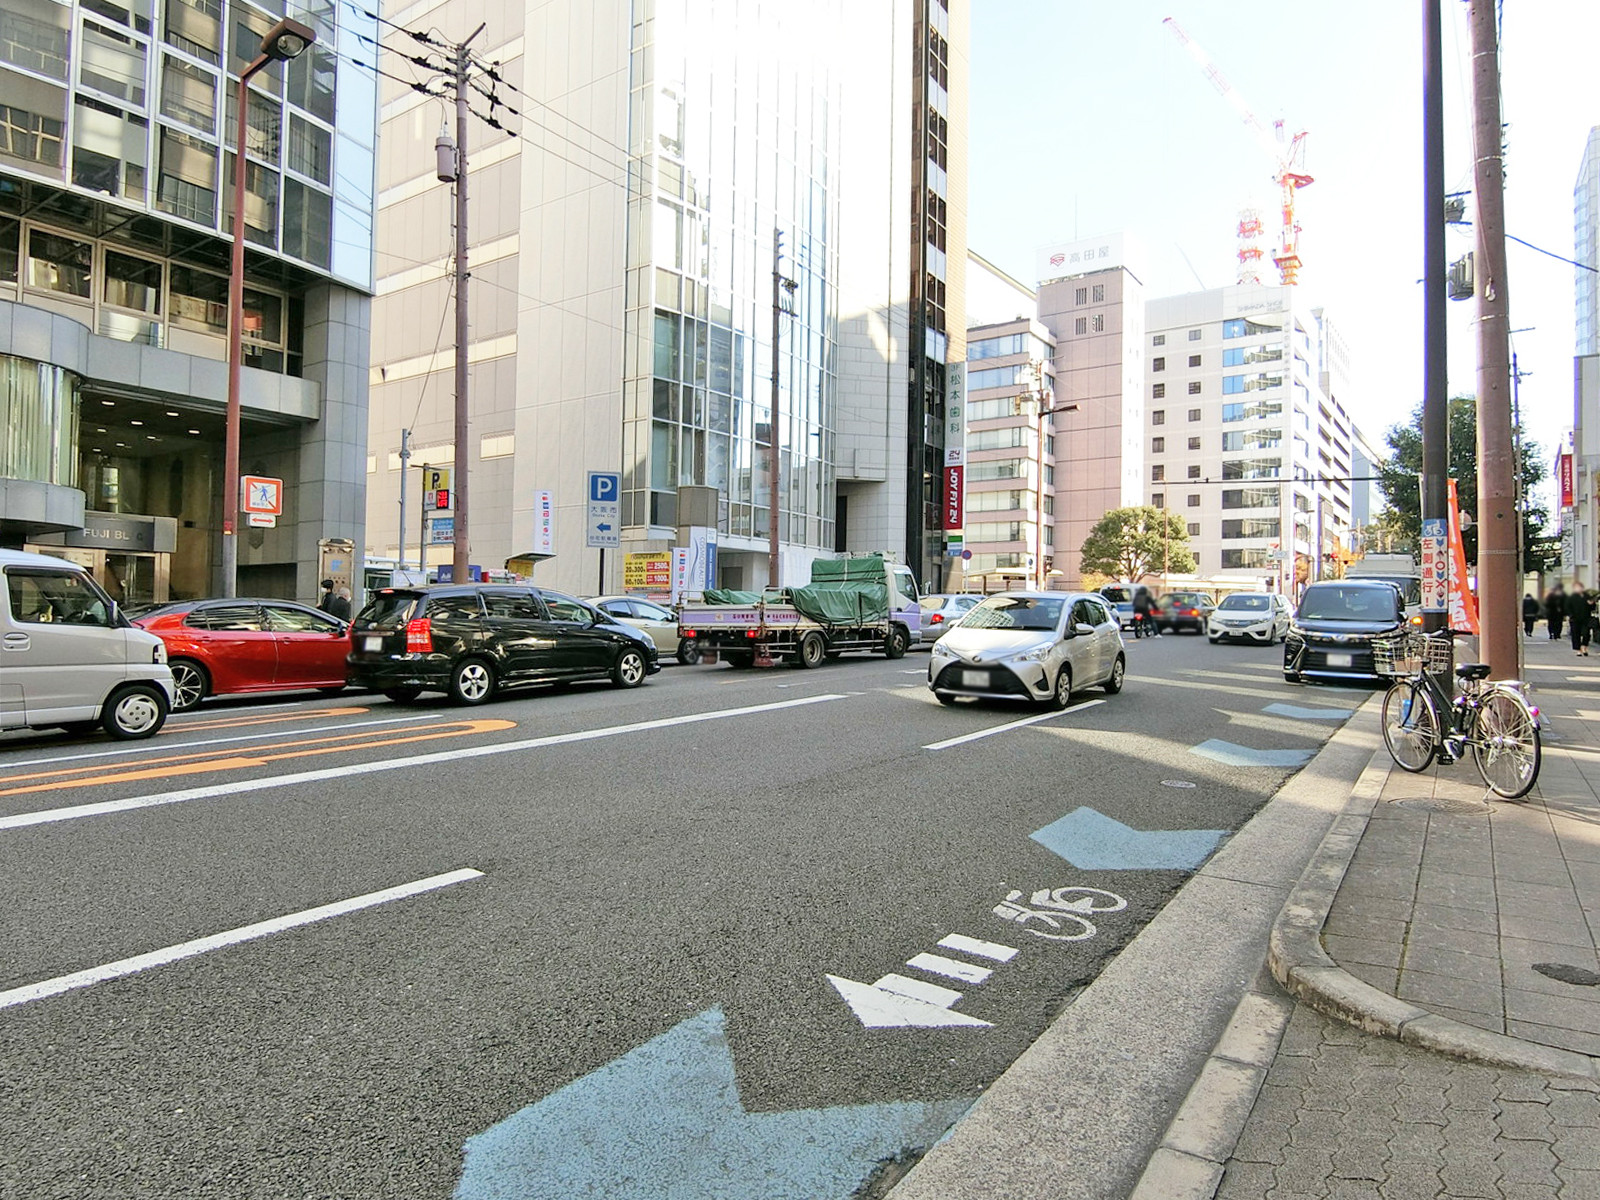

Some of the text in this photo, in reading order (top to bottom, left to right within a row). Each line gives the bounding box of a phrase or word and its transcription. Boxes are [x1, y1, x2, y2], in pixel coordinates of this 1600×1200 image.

[949, 374, 960, 434] 松本歯科
[597, 477, 613, 499] P
[591, 506, 617, 514] 大阪市
[83, 528, 109, 539] FUJI
